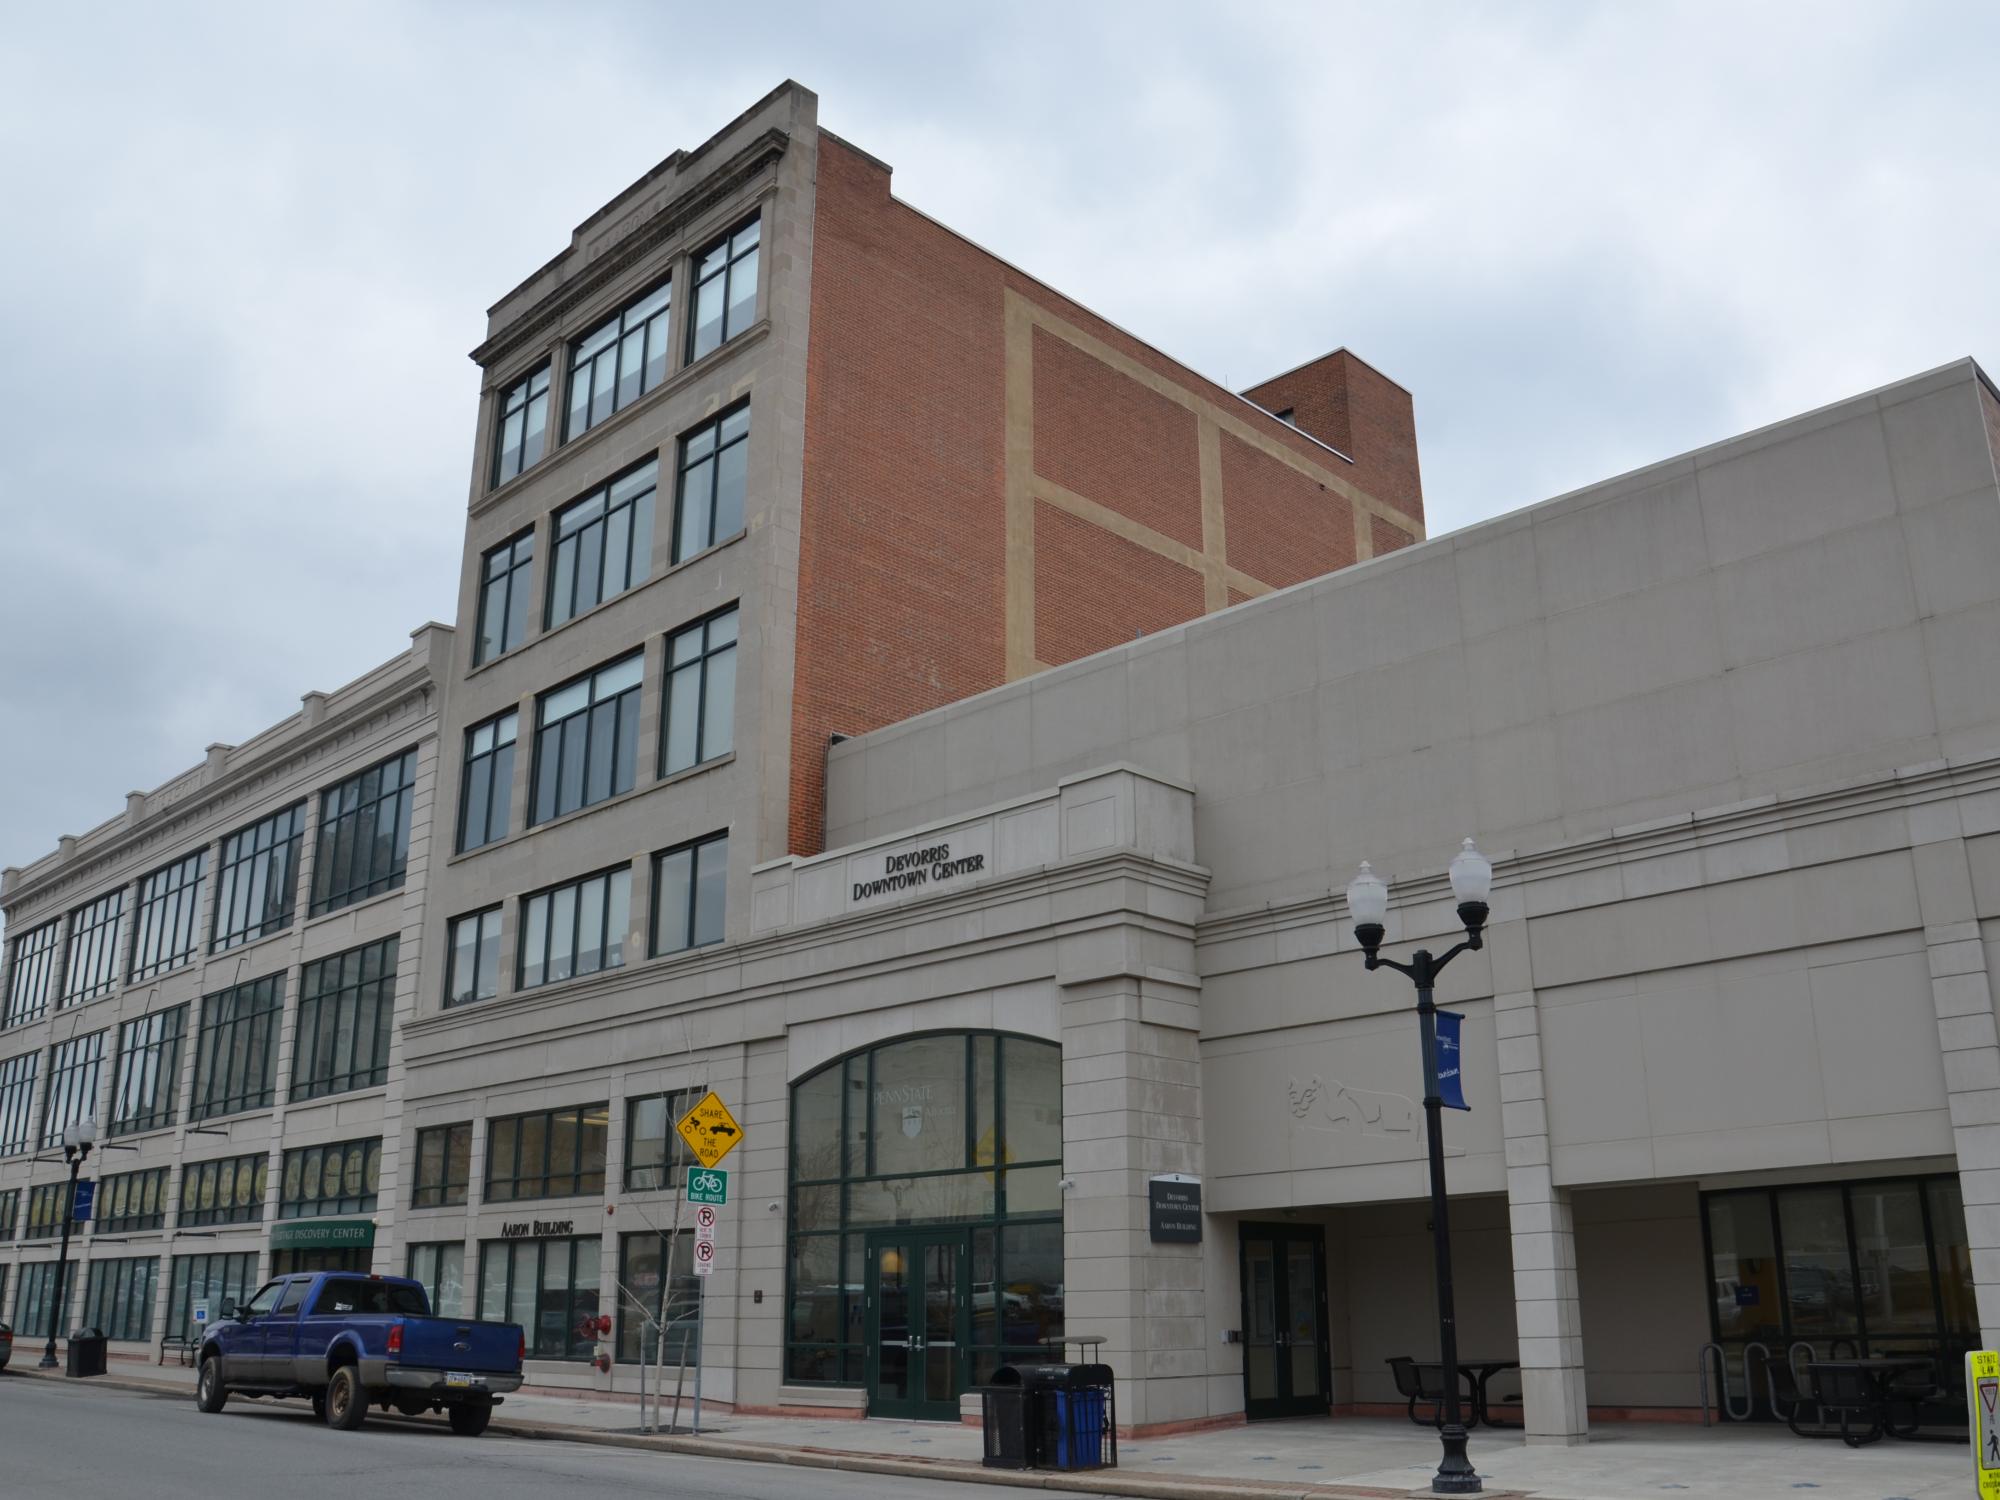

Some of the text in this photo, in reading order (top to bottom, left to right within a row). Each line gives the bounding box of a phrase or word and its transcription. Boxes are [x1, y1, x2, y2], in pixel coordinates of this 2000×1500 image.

[886, 844, 950, 874] DEVORRIS
[853, 854, 985, 901] DOWNTOWN CENTER
[699, 1108, 724, 1119] SHARE
[703, 1137, 718, 1147] THE
[699, 1148, 719, 1159] ROAD
[690, 1192, 723, 1203] BIKE ROUTE
[295, 1228, 330, 1240] DISCOVERY
[332, 1227, 366, 1239] CENTER
[501, 1220, 574, 1237] AARON BUILDING
[1977, 1354, 1996, 1365] STATE
[1982, 1366, 1994, 1375] LAW
